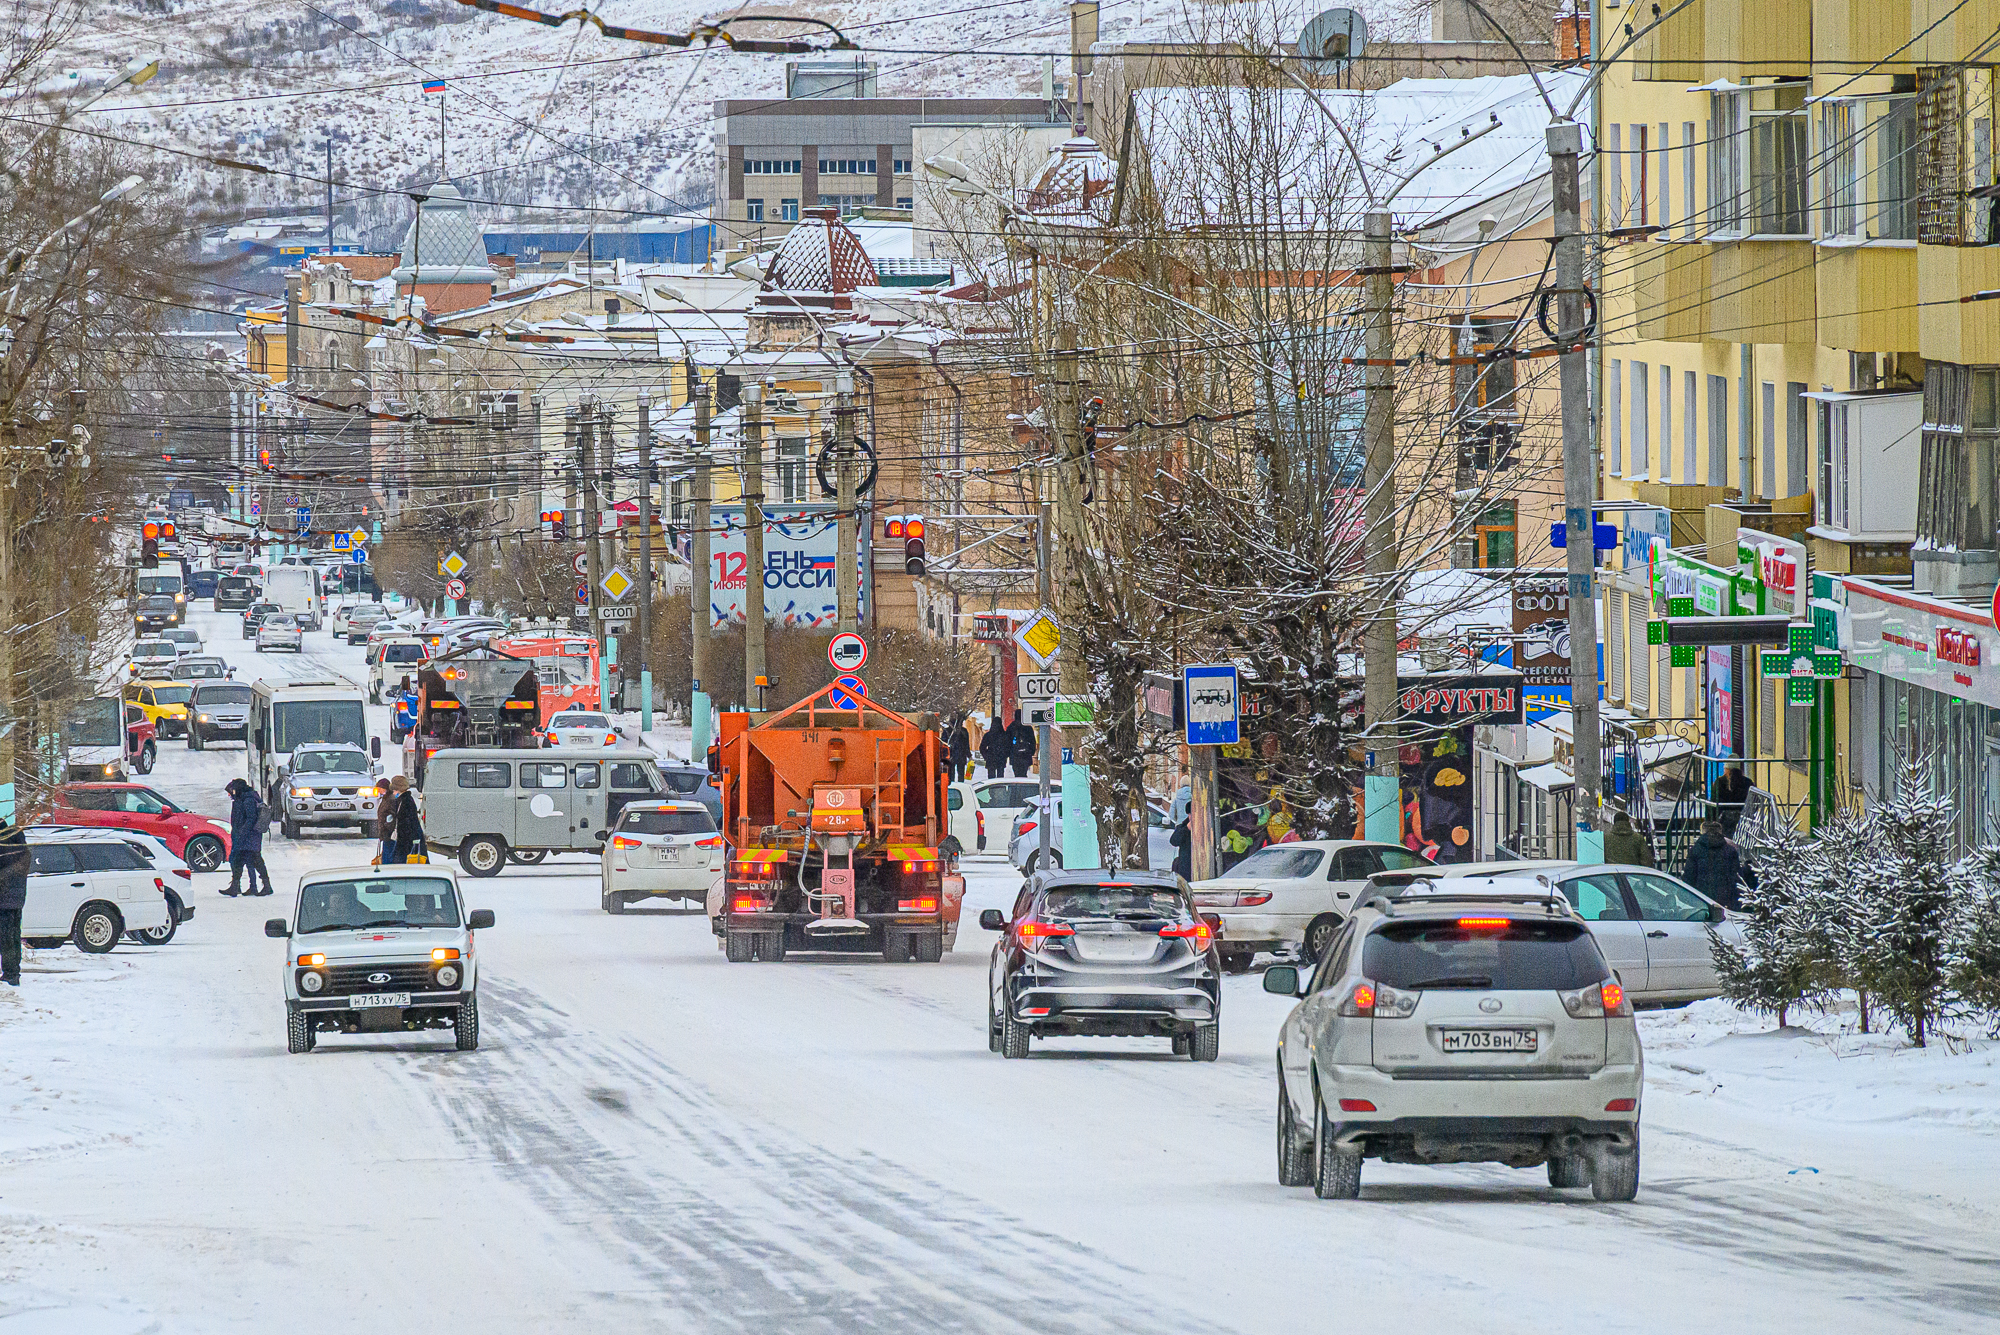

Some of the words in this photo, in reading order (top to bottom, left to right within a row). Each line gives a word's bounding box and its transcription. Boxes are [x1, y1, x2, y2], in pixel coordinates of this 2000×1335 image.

[892, 523, 901, 535] 18
[713, 551, 747, 582] 12
[763, 550, 814, 570] ЕНЬ
[713, 580, 747, 591] ИЮНЯ
[763, 569, 836, 589] ОССИ
[1515, 594, 1570, 611] ФОТ
[603, 607, 633, 619] СТОП
[1522, 666, 1571, 675] СЕРОКОП
[1026, 678, 1060, 695] СТО
[1522, 675, 1573, 684] АСПЕЧАТ
[1402, 686, 1515, 714] ФРУКТЫ
[1449, 1033, 1512, 1047] М703ВН
[1516, 1031, 1532, 1044] 75
